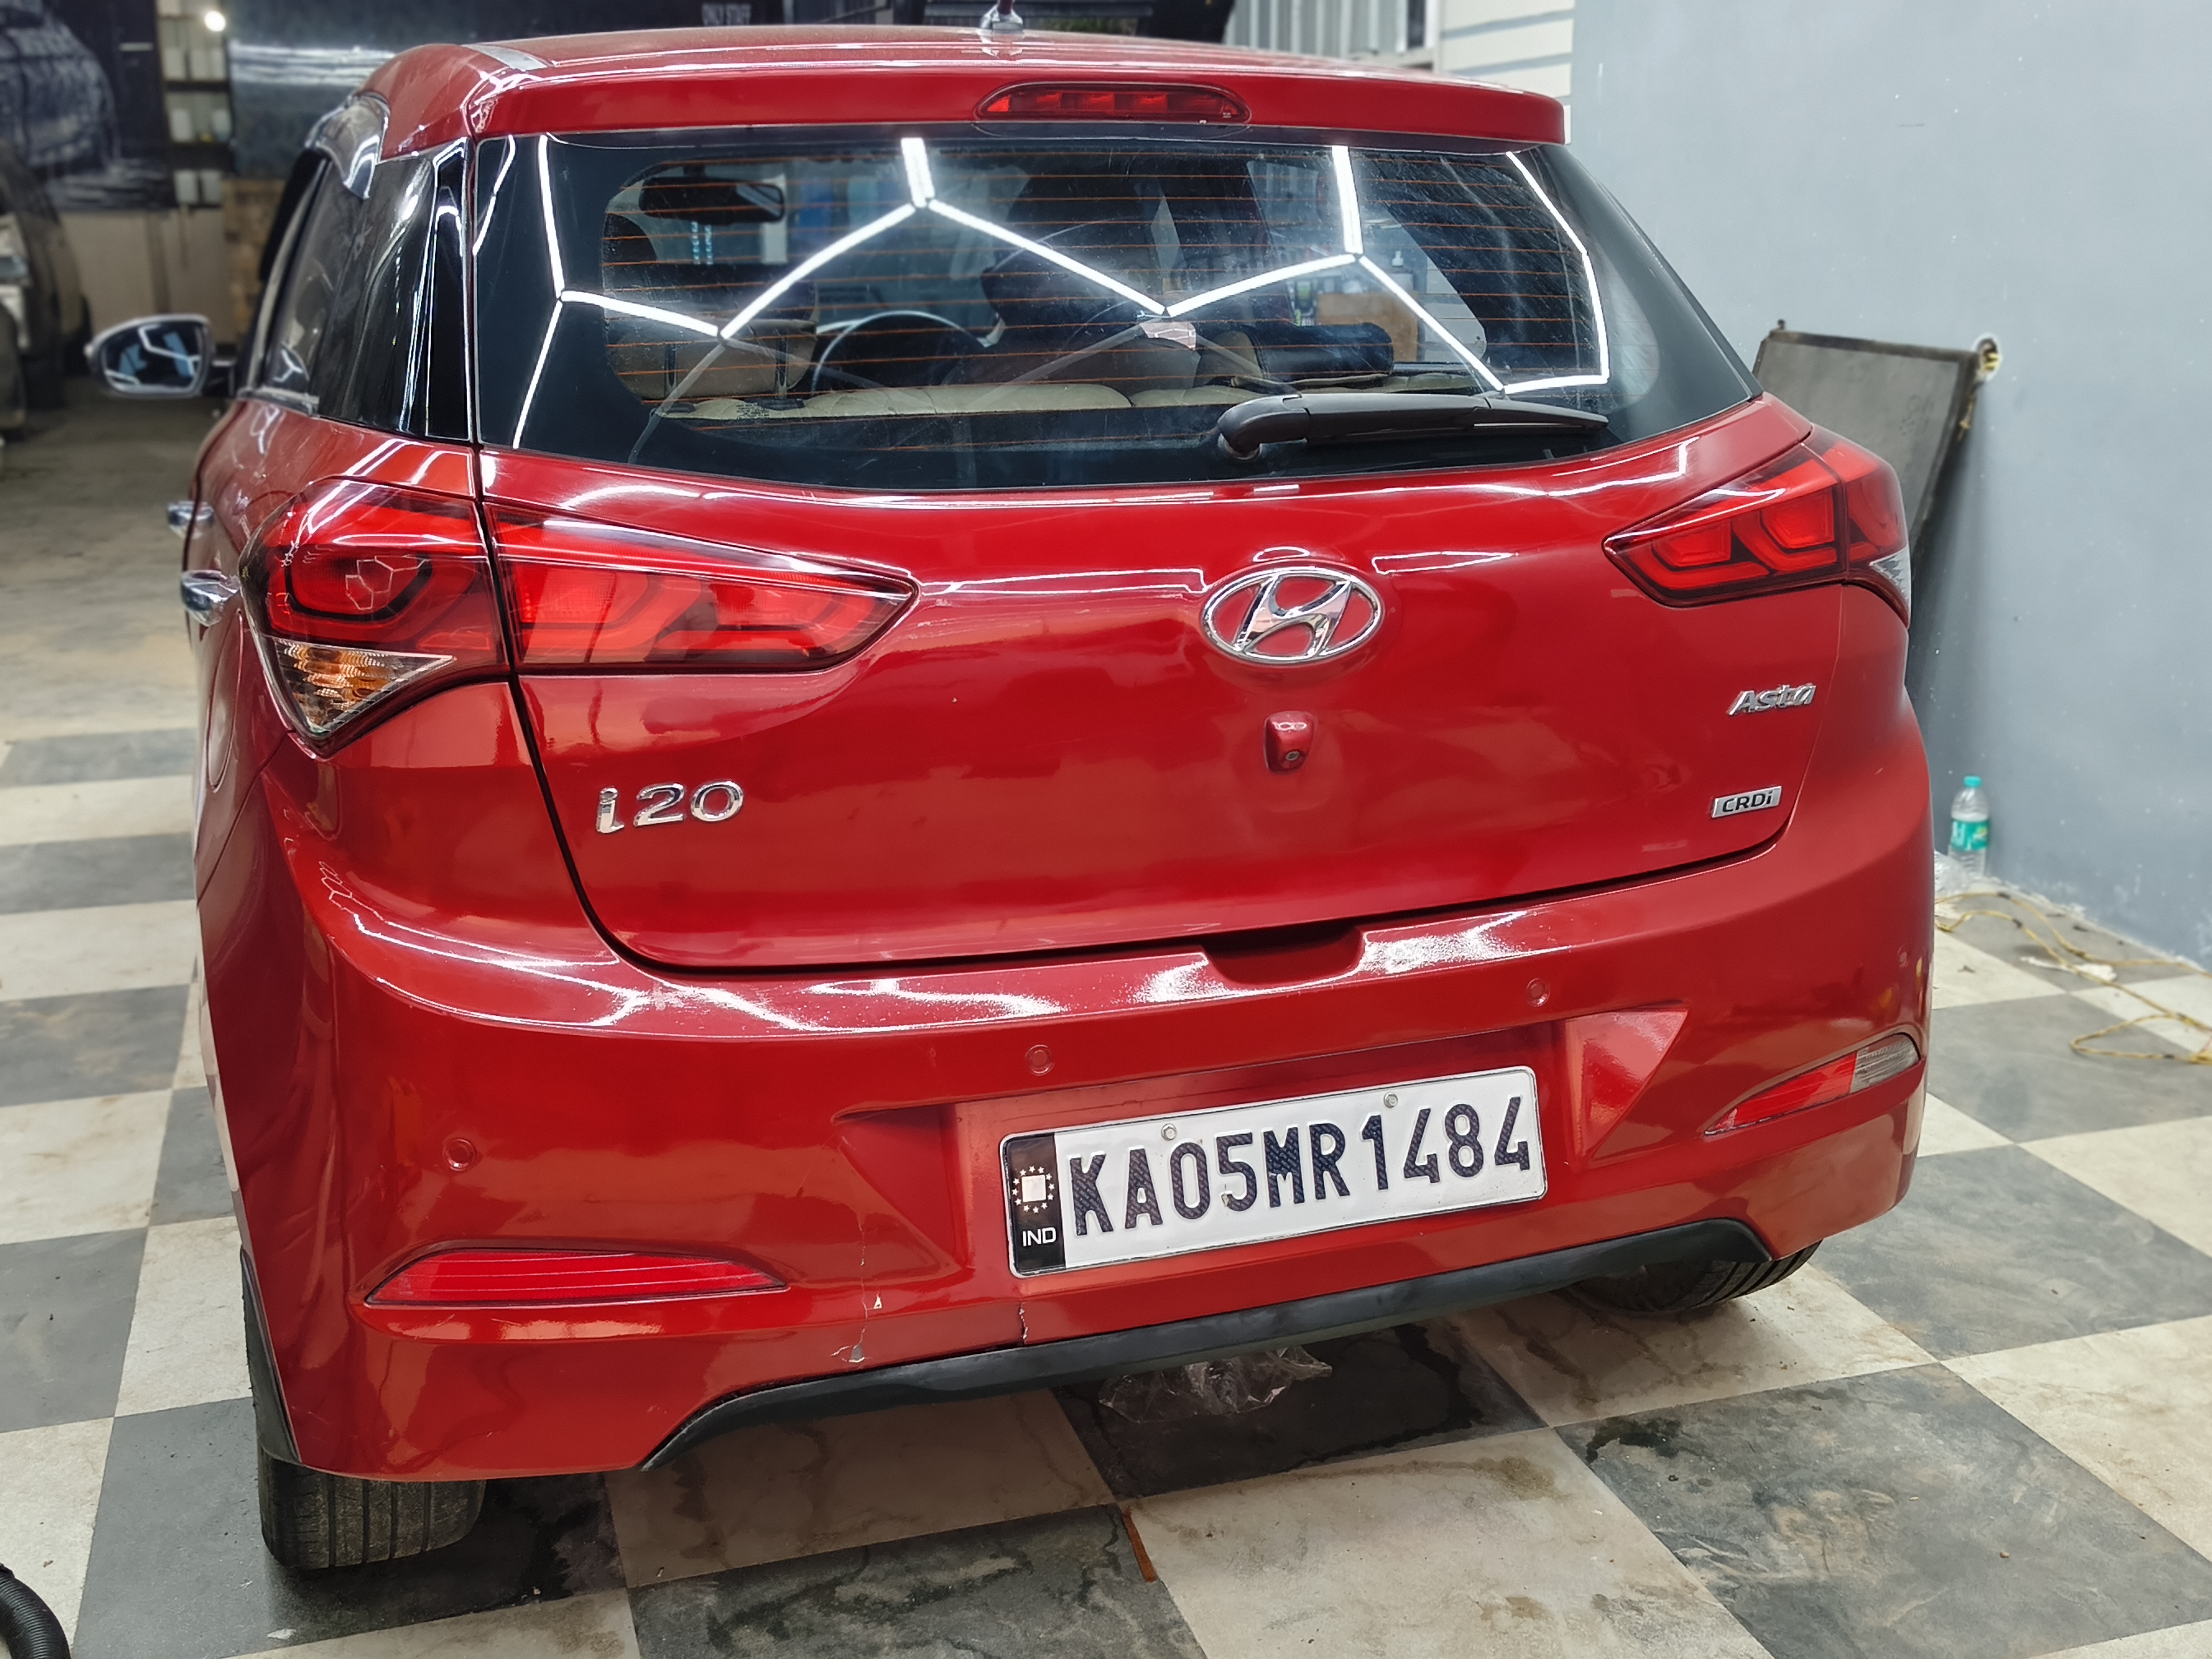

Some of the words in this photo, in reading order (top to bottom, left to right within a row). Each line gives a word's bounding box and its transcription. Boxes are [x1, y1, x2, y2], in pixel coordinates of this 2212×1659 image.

[1727, 683, 1817, 716] Asta
[596, 780, 744, 833] i20
[1722, 790, 1773, 813] CRDi
[1070, 1097, 1530, 1236] KA05MR1484
[1023, 1227, 1056, 1246] IND
